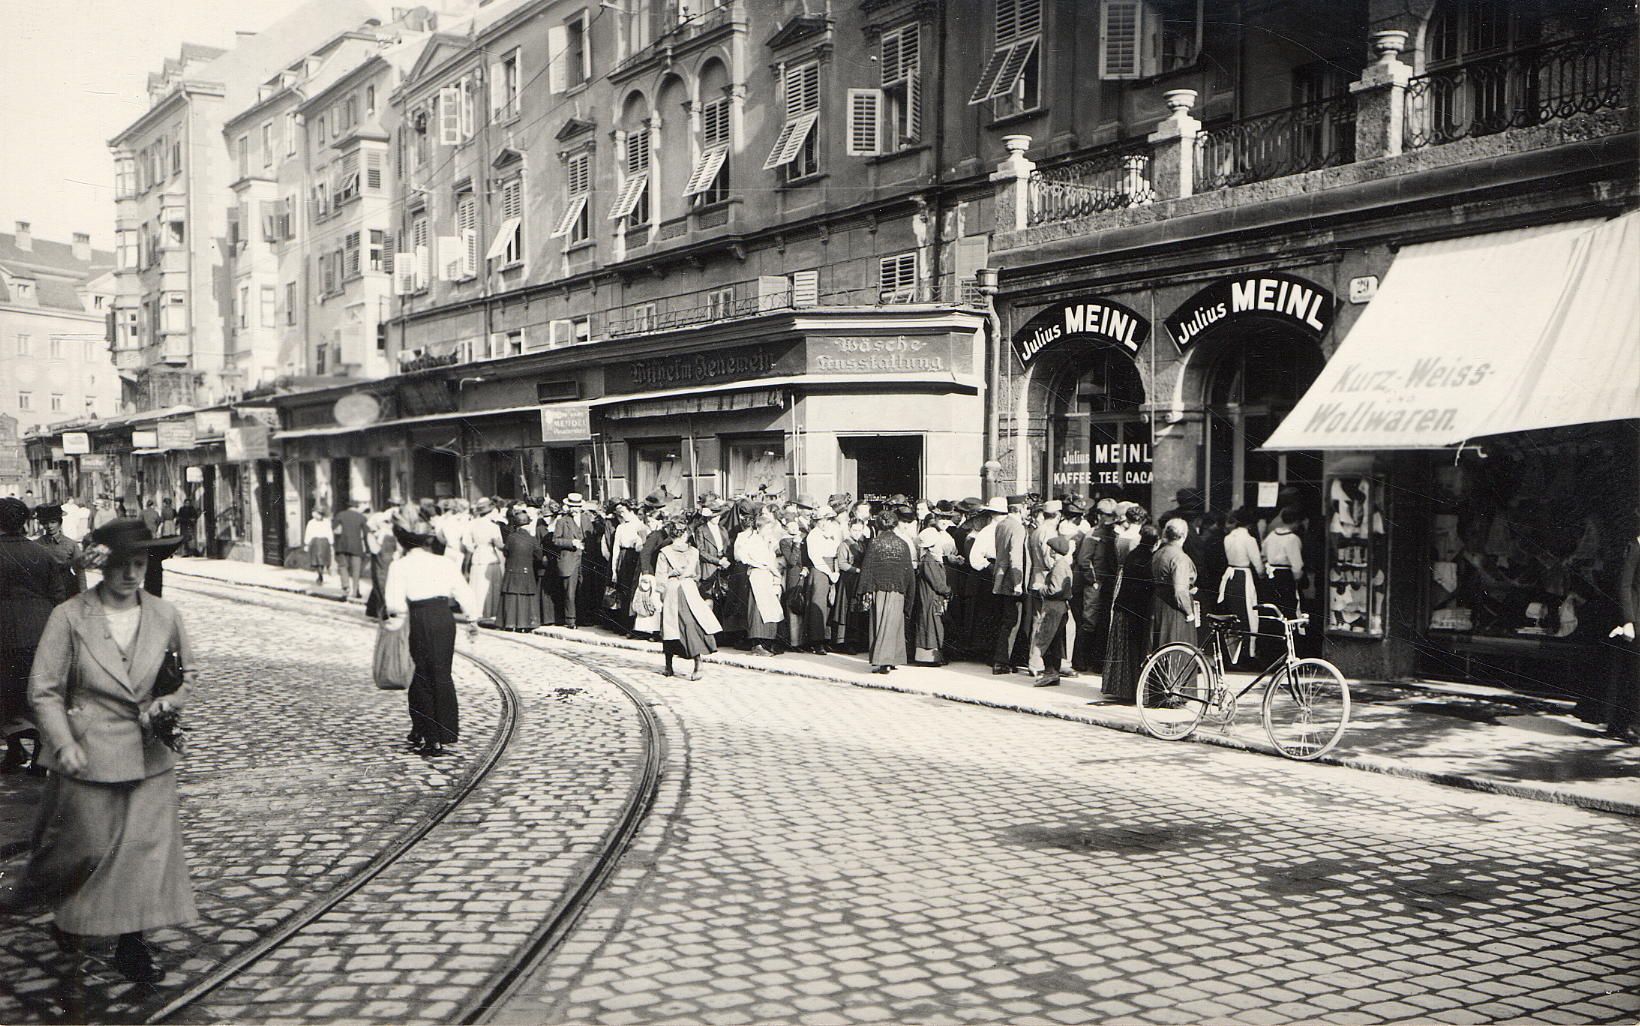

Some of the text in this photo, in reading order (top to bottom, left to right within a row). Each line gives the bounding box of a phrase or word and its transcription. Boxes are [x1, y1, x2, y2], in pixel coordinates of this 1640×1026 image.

[1178, 279, 1323, 344] Julius MEINL
[1022, 304, 1138, 360] Julius MEINL
[630, 357, 692, 385] Wilhelm
[1304, 401, 1458, 433] Wollwaren.
[1063, 443, 1153, 465] Julius MEINL
